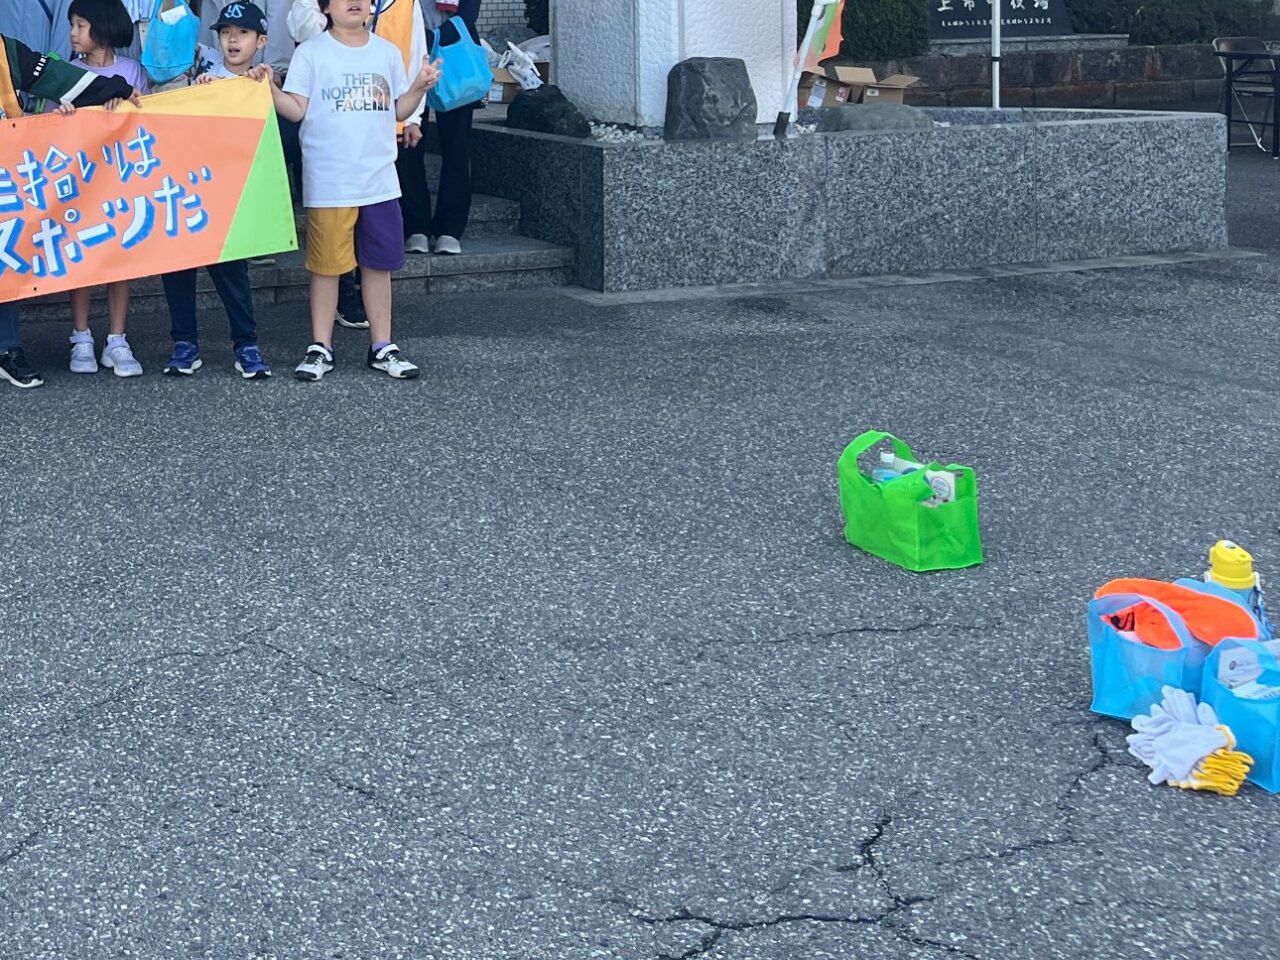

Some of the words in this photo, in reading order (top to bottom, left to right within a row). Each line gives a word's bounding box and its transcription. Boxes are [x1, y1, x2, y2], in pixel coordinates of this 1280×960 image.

[342, 73, 371, 85] THE
[321, 86, 372, 100] NORTH
[335, 100, 373, 112] FACE
